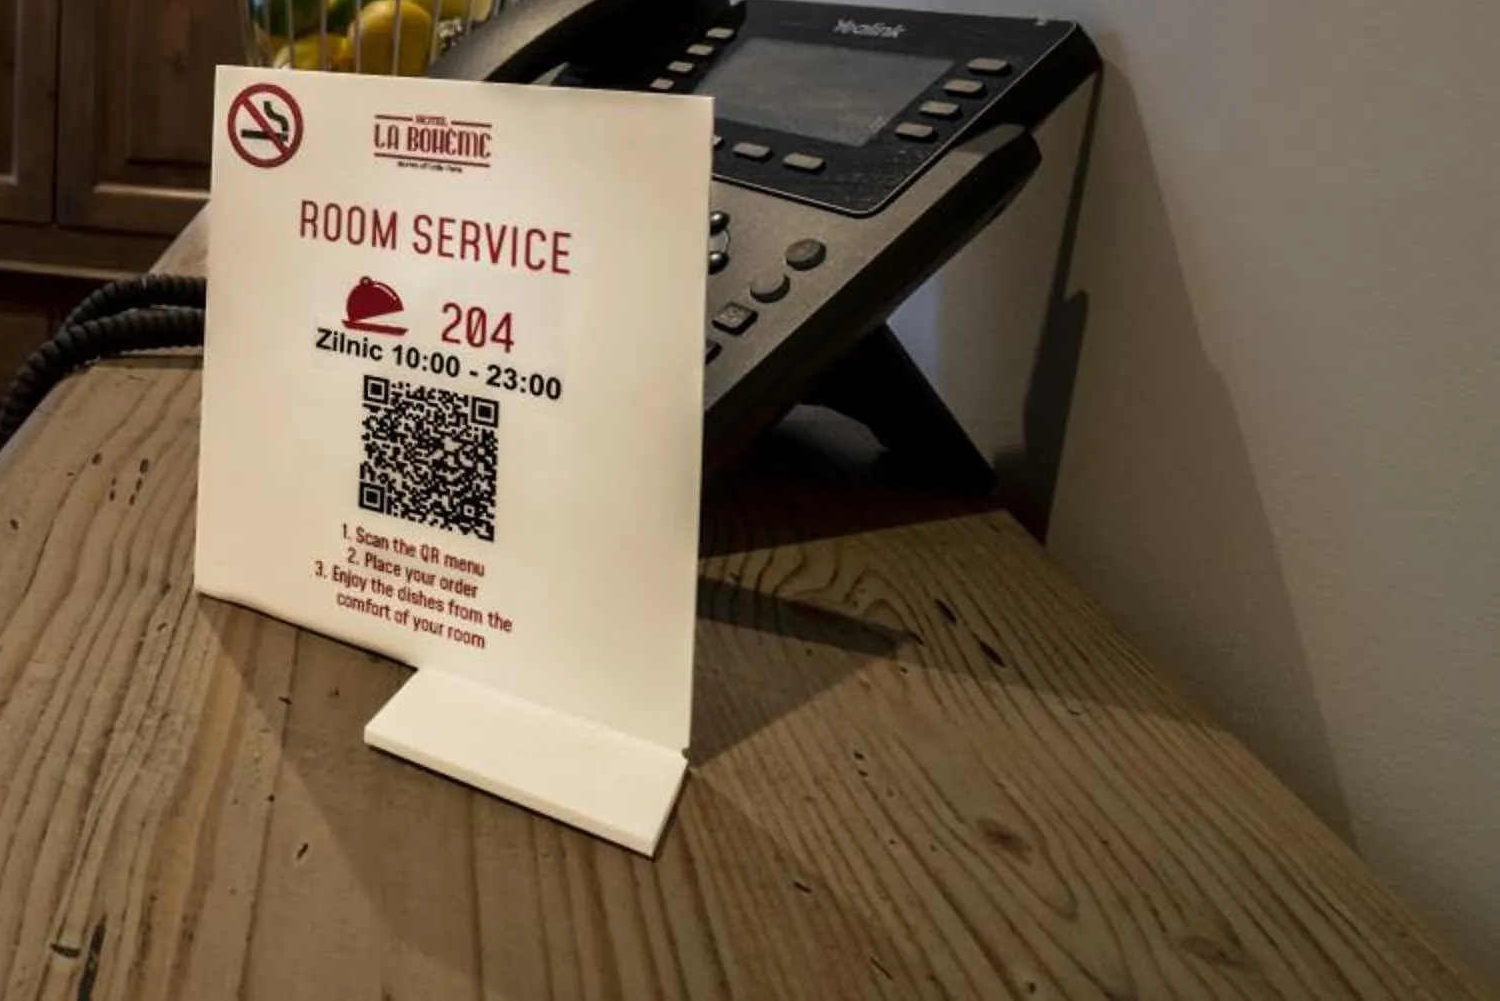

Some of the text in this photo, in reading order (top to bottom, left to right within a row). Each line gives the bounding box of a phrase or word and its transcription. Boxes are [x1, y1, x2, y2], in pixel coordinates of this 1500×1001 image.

[374, 123, 399, 150] LA
[301, 199, 572, 274] ROOM SERVICE
[441, 302, 515, 353] 204
[315, 327, 384, 362] Zilnic
[391, 344, 460, 378] 10:00
[485, 363, 563, 401] 23:00
[343, 522, 486, 577] 1. Scan the QR menu
[347, 546, 479, 599] 2. Place your order
[314, 560, 514, 634] 3. Enjoy the dishes from the
[336, 592, 486, 650] comfort of your room
